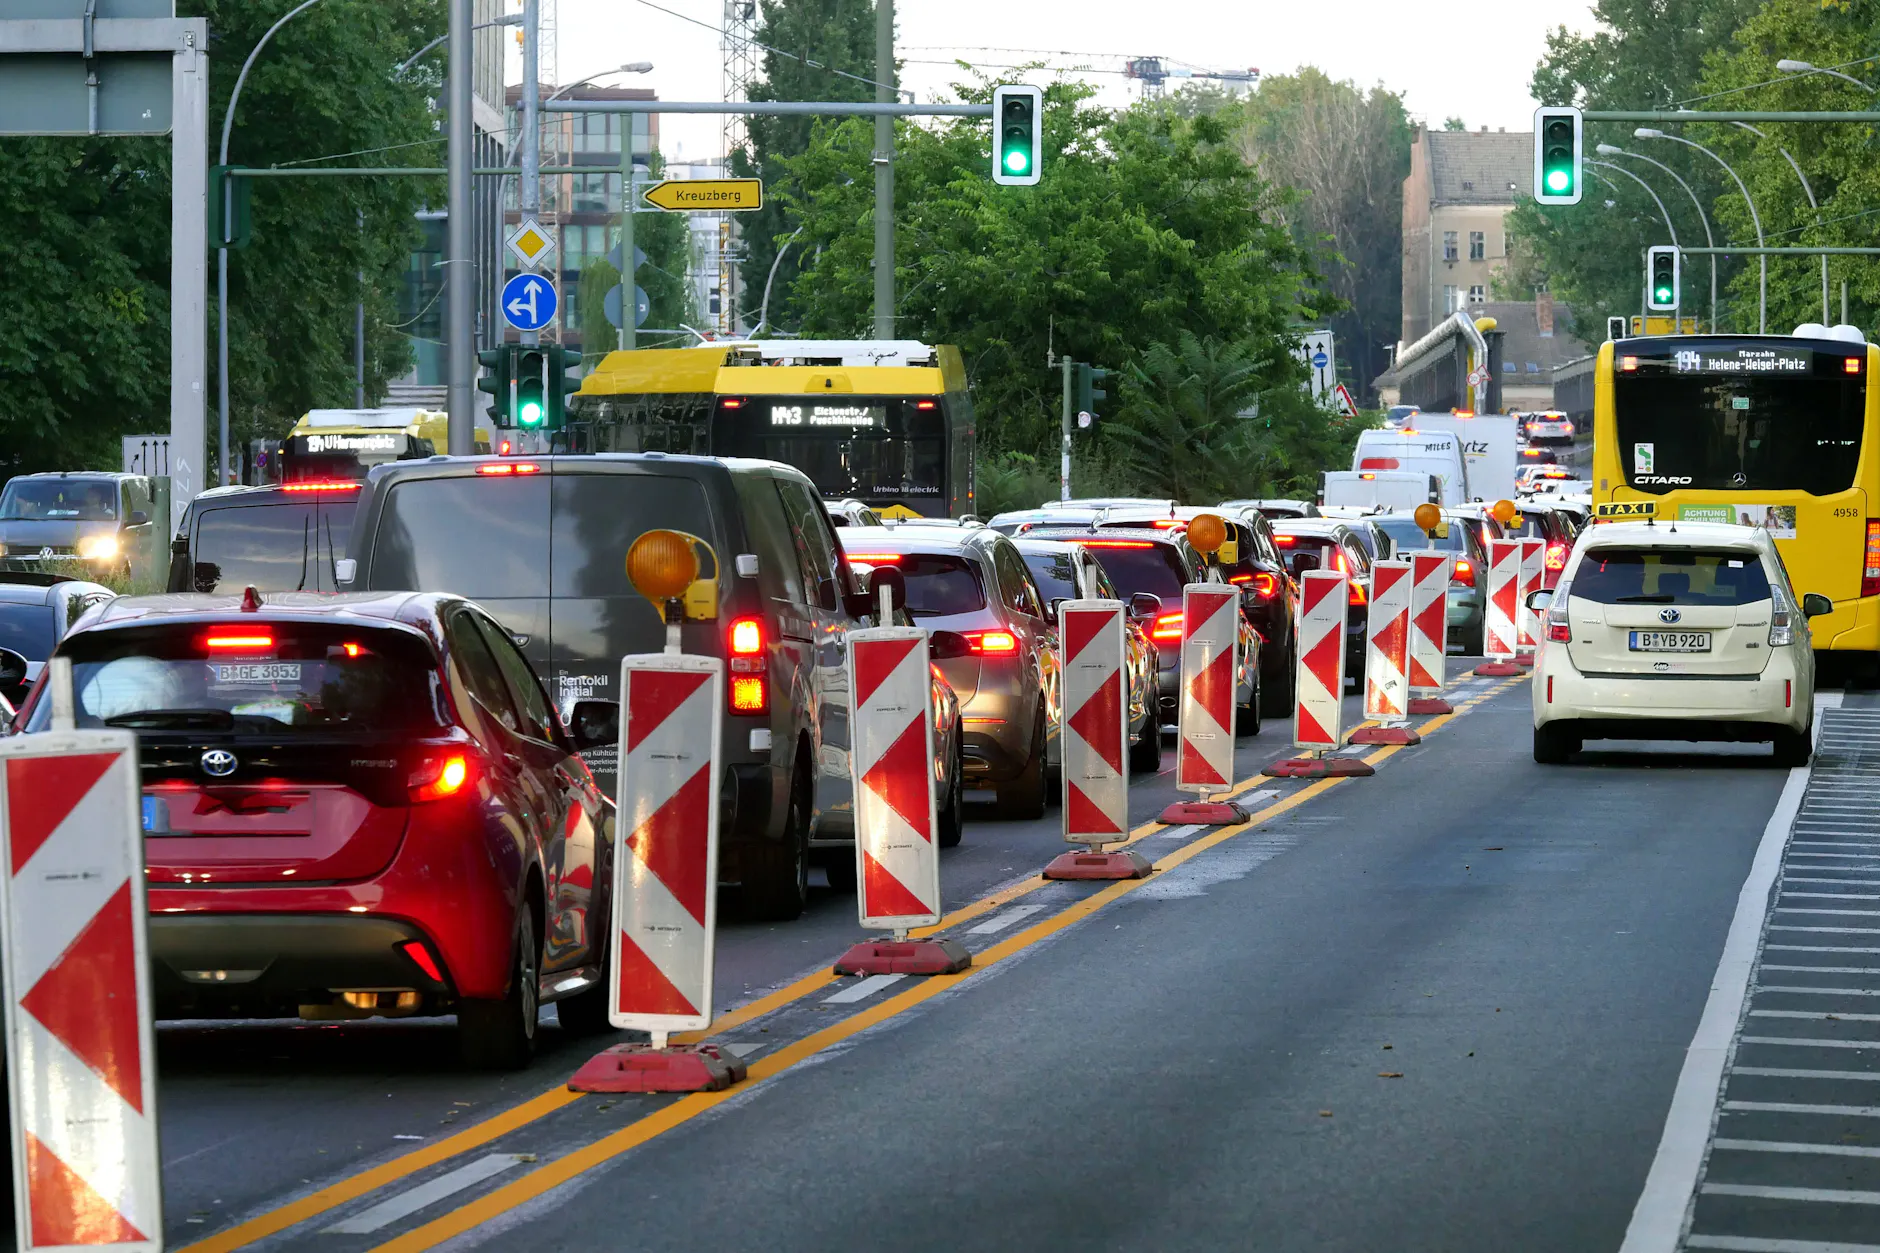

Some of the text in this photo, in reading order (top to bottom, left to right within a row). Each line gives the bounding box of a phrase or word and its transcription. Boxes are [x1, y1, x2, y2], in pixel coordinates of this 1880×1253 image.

[676, 190, 741, 203] Kreuzberg
[1739, 350, 1776, 358] Marzahn
[1675, 350, 1701, 371] 194
[1709, 358, 1806, 370] Helene-Weigel-Platz
[1425, 442, 1451, 452] MILES
[1634, 476, 1693, 485] CITARO
[909, 486, 940, 494] electric
[1605, 503, 1648, 515] TAXI
[1684, 509, 1727, 517] ACHTUNG
[1834, 508, 1859, 518] 4958
[1642, 634, 1705, 648] B YB 920
[220, 665, 299, 679] B GE 3853
[559, 675, 608, 686] Rentokil
[559, 686, 593, 697] Initial
